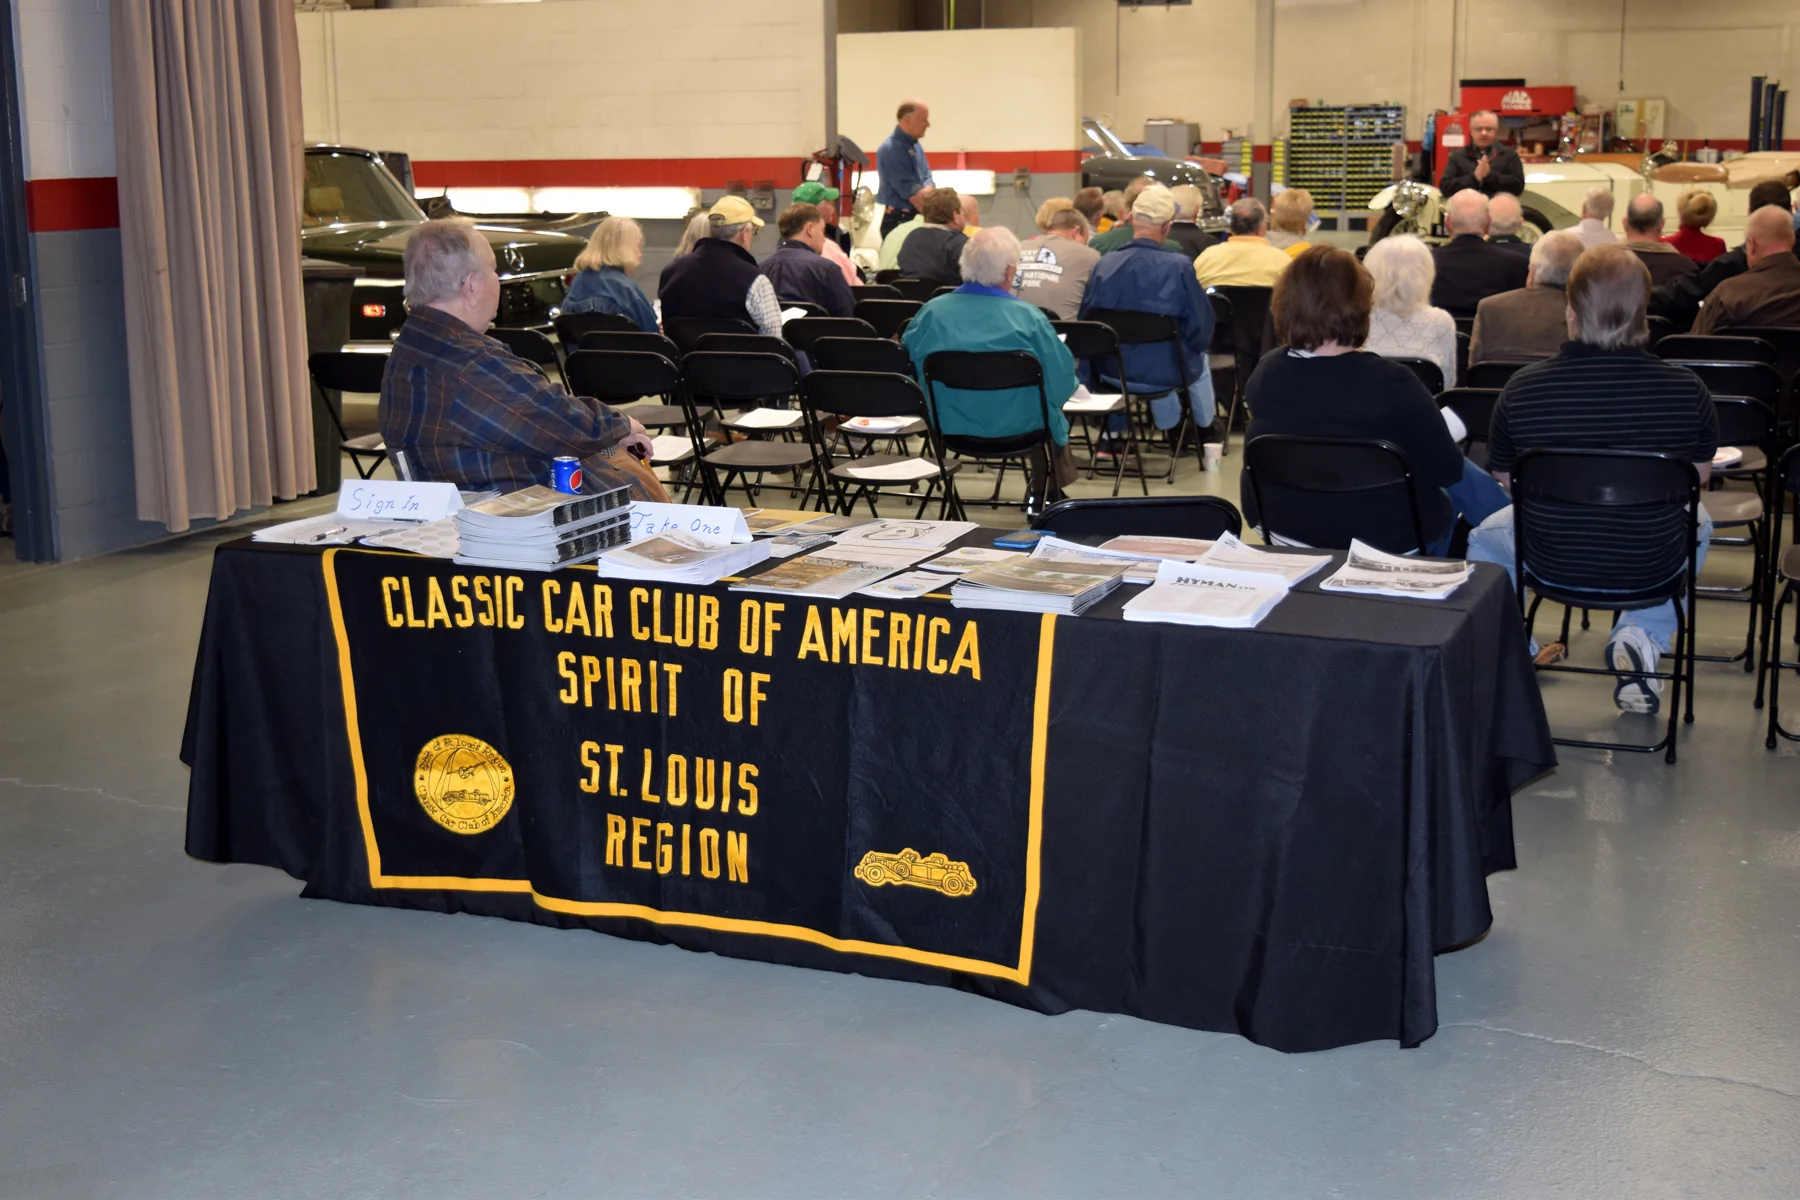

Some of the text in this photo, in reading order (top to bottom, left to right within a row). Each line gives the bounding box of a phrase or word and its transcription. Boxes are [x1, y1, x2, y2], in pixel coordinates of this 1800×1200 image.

[350, 487, 421, 514] Sign In
[630, 511, 722, 536] Take One
[1175, 576, 1238, 589] HYMAN
[382, 575, 982, 681] CLASSIC CAR CLUB OF AMERICA
[557, 650, 771, 727] SPIRIT OF
[482, 746, 508, 774] Region
[579, 740, 759, 817] ST. LOUIS
[439, 814, 457, 828] Car
[458, 819, 481, 830] Club
[605, 813, 749, 884] REGION
